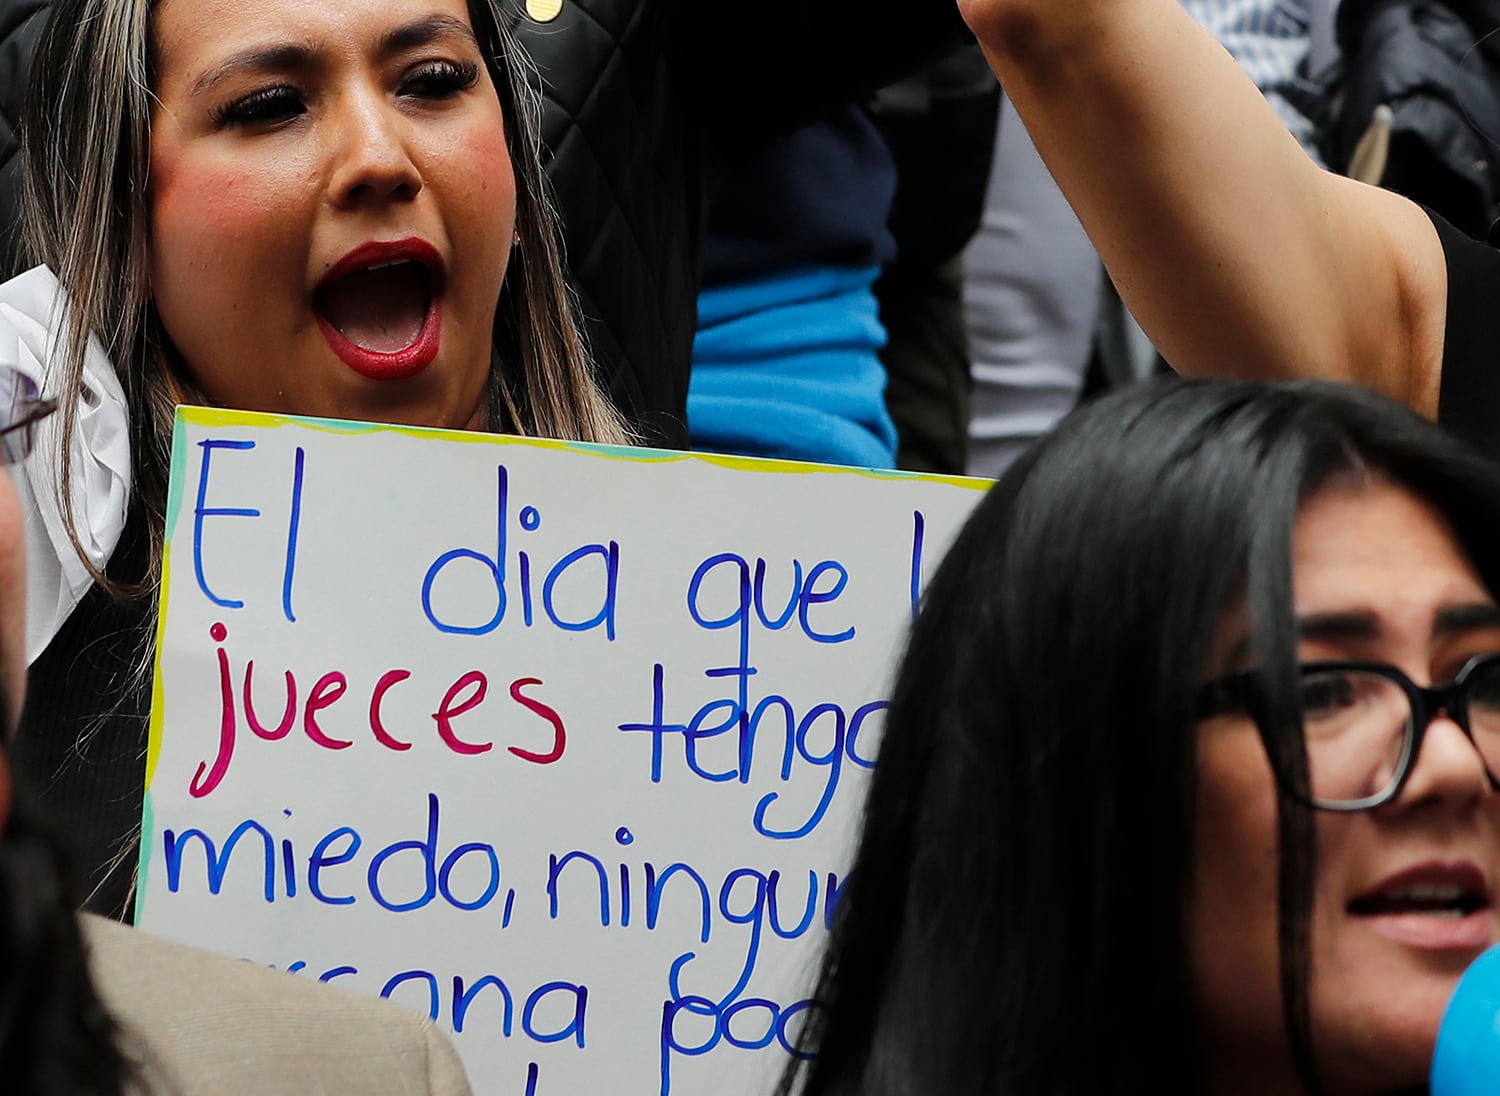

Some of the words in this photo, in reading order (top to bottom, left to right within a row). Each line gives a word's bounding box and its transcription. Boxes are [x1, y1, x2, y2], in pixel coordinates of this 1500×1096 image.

[194, 439, 304, 622] El
[421, 465, 618, 640] dia
[687, 551, 855, 714] que
[189, 622, 567, 799] jueces
[162, 793, 516, 930] miedo,
